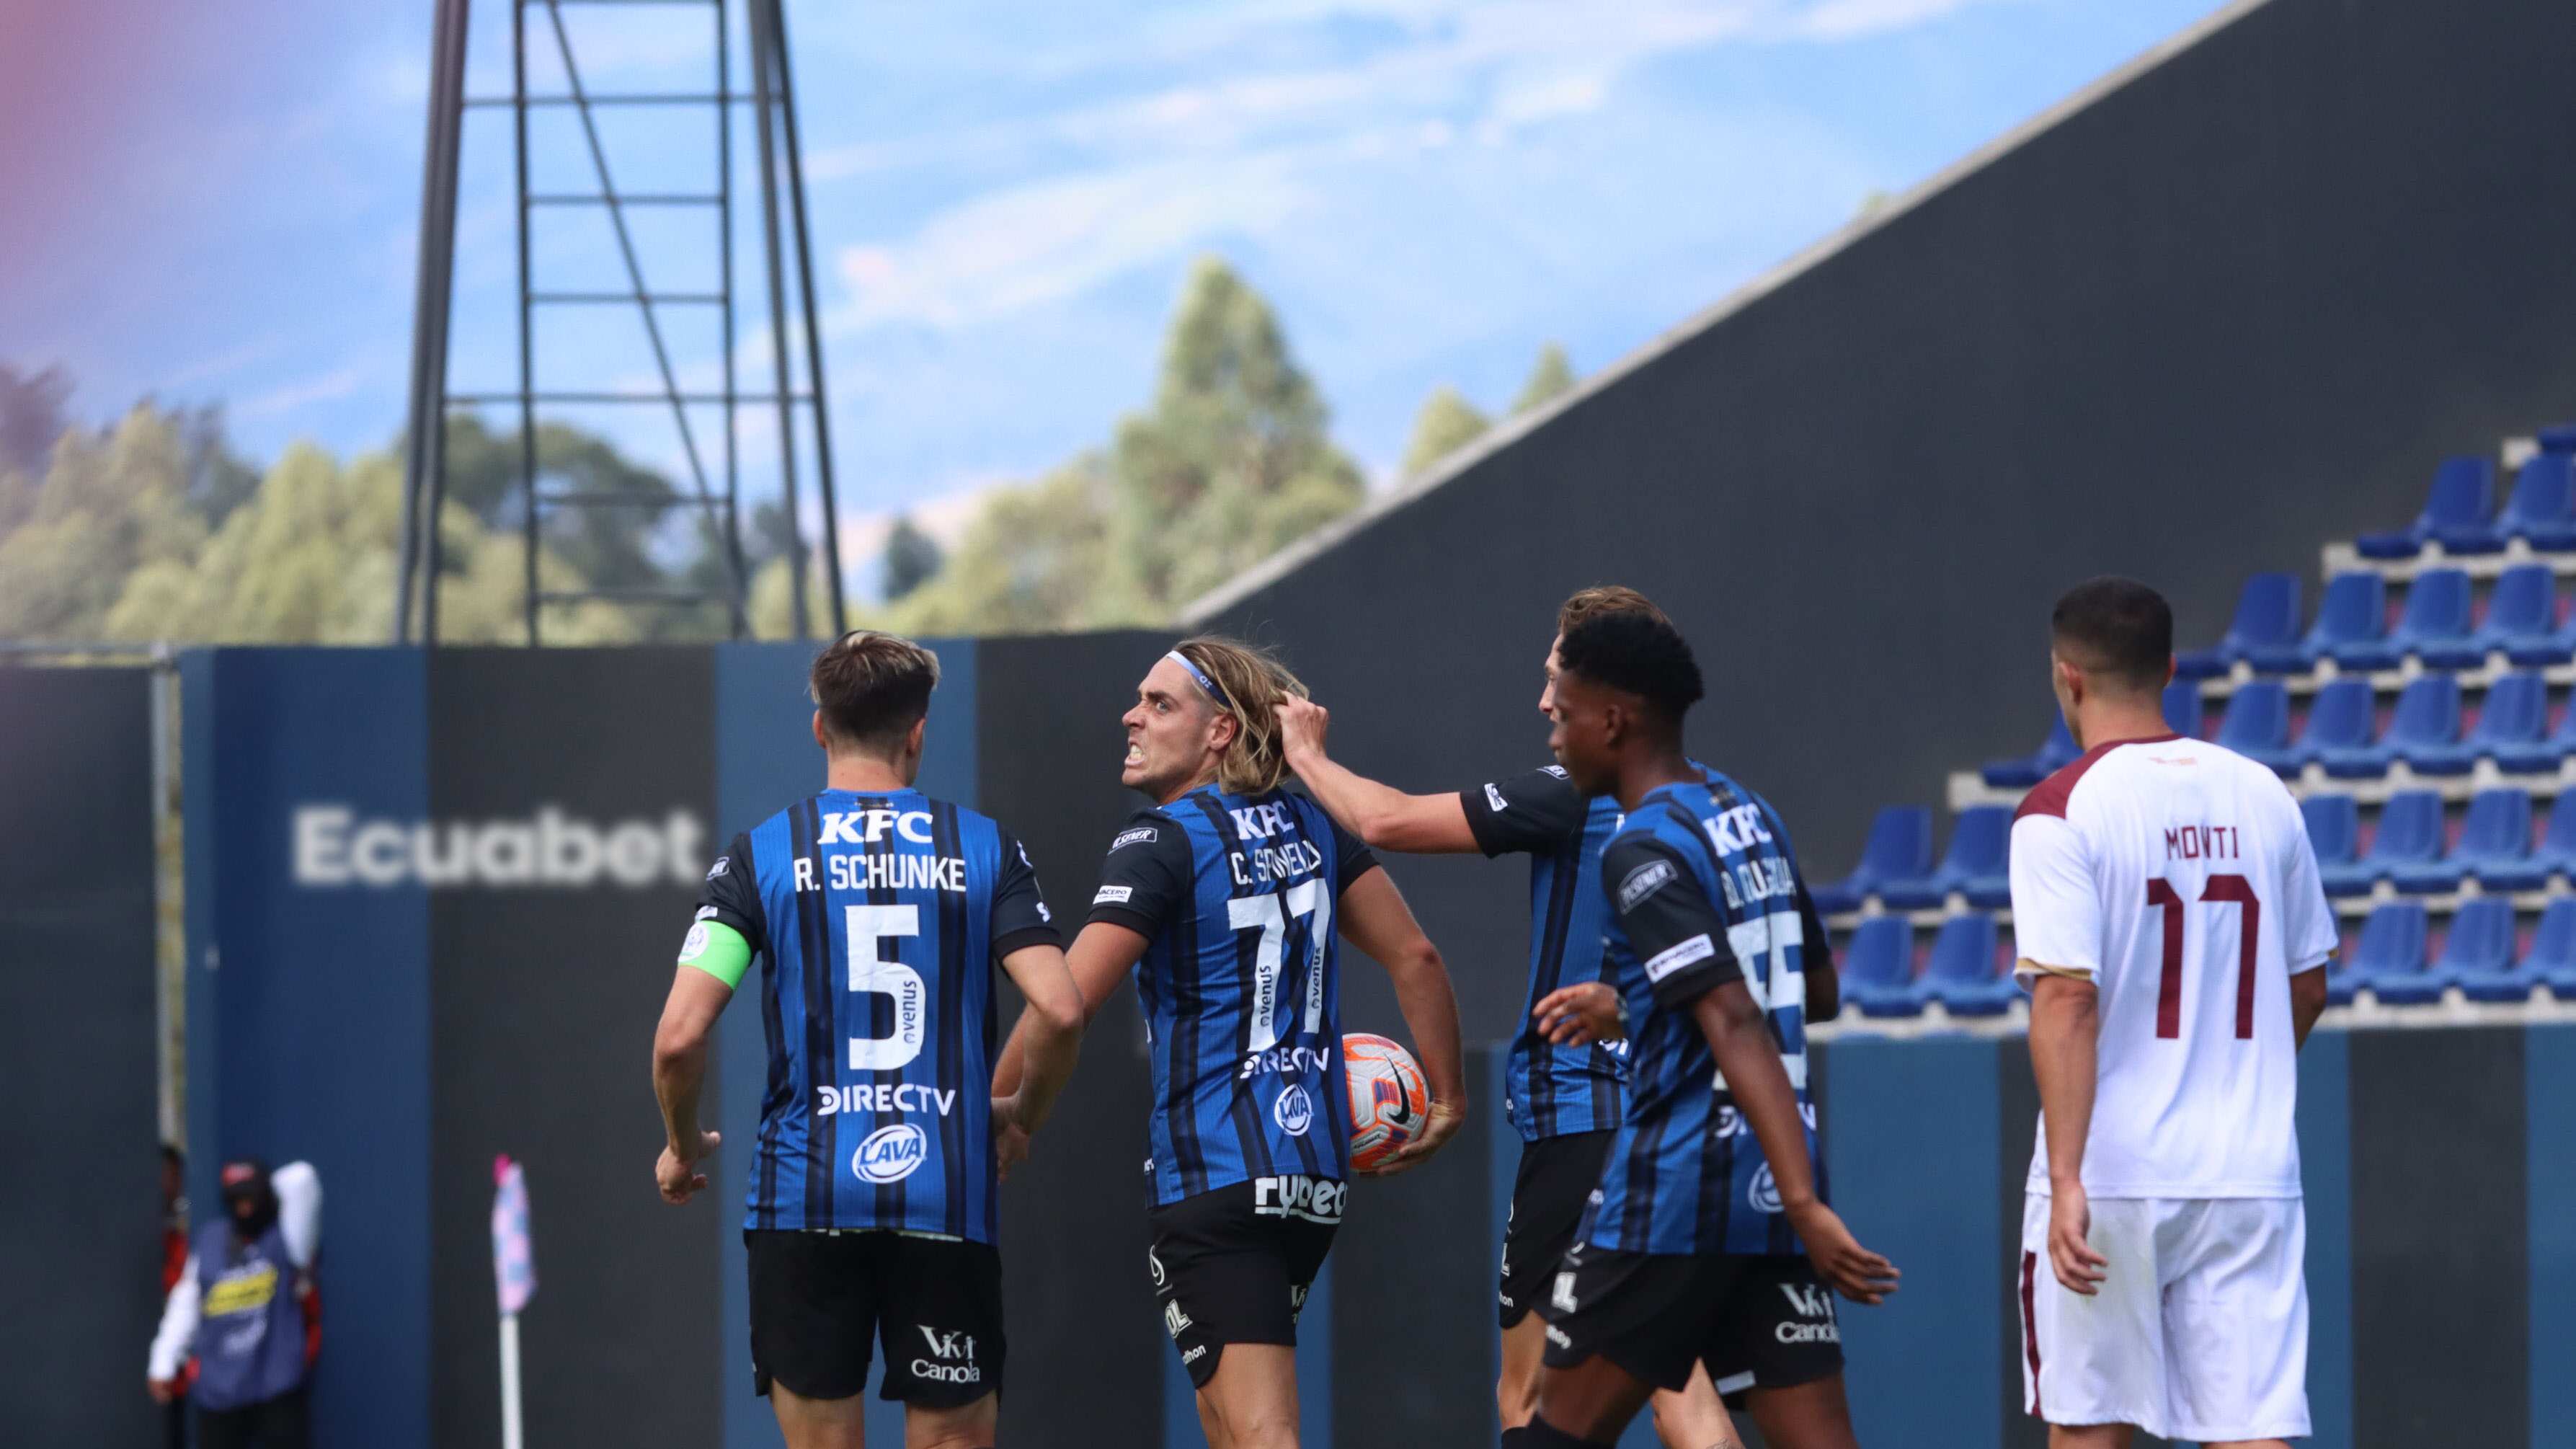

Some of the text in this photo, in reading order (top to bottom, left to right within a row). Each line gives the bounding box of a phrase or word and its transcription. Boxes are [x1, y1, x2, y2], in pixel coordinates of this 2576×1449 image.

[817, 809, 933, 845] KFC
[1230, 800, 1295, 840] KFC
[294, 804, 706, 887] Ecuabet
[794, 854, 967, 892] R. SCHUNKE
[1230, 851, 1253, 885] C.
[1227, 877, 1331, 1051] 77
[1311, 947, 1321, 996] venus
[845, 904, 926, 1070] 5
[902, 980, 917, 1033] venus
[1260, 965, 1272, 1011] venus
[817, 1083, 956, 1116] DIRECTV
[858, 1136, 921, 1166] LAVA
[911, 1358, 981, 1383] Canola
